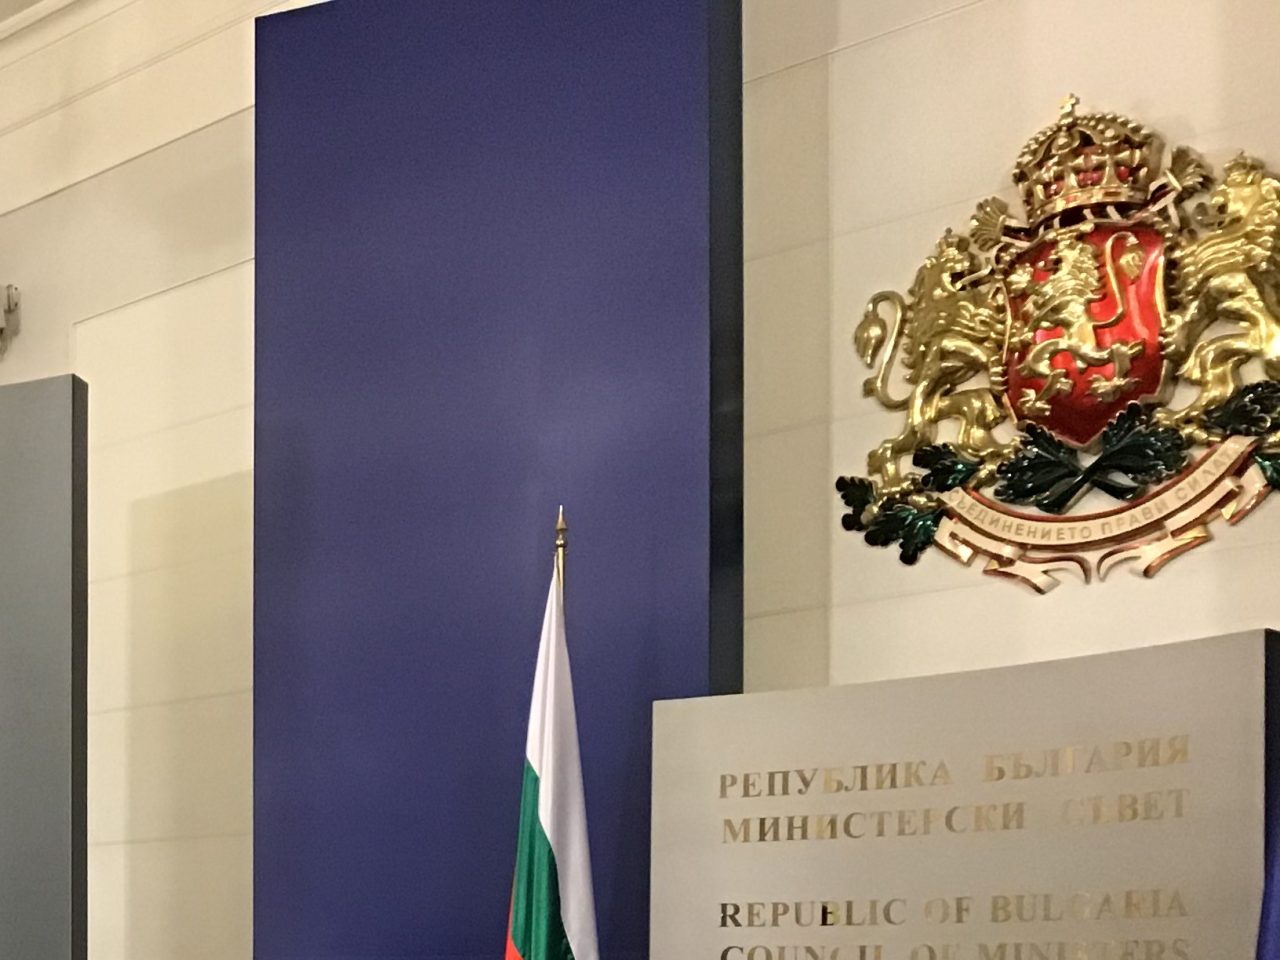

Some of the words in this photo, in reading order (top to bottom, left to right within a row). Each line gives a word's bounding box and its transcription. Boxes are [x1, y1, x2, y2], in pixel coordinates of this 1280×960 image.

[949, 489, 1092, 542] СЪЕДИНЕНИЕТО
[1101, 500, 1170, 536] ПРАВИ
[718, 758, 955, 799] РЕПУБЛИКА
[982, 734, 1191, 783] БЪЛГАРИЯ
[721, 801, 1026, 844] МИНИСТЕРСКИ
[718, 897, 907, 928] REPUBLIC
[923, 895, 972, 924] OF
[989, 887, 1189, 923] BULGARIA
